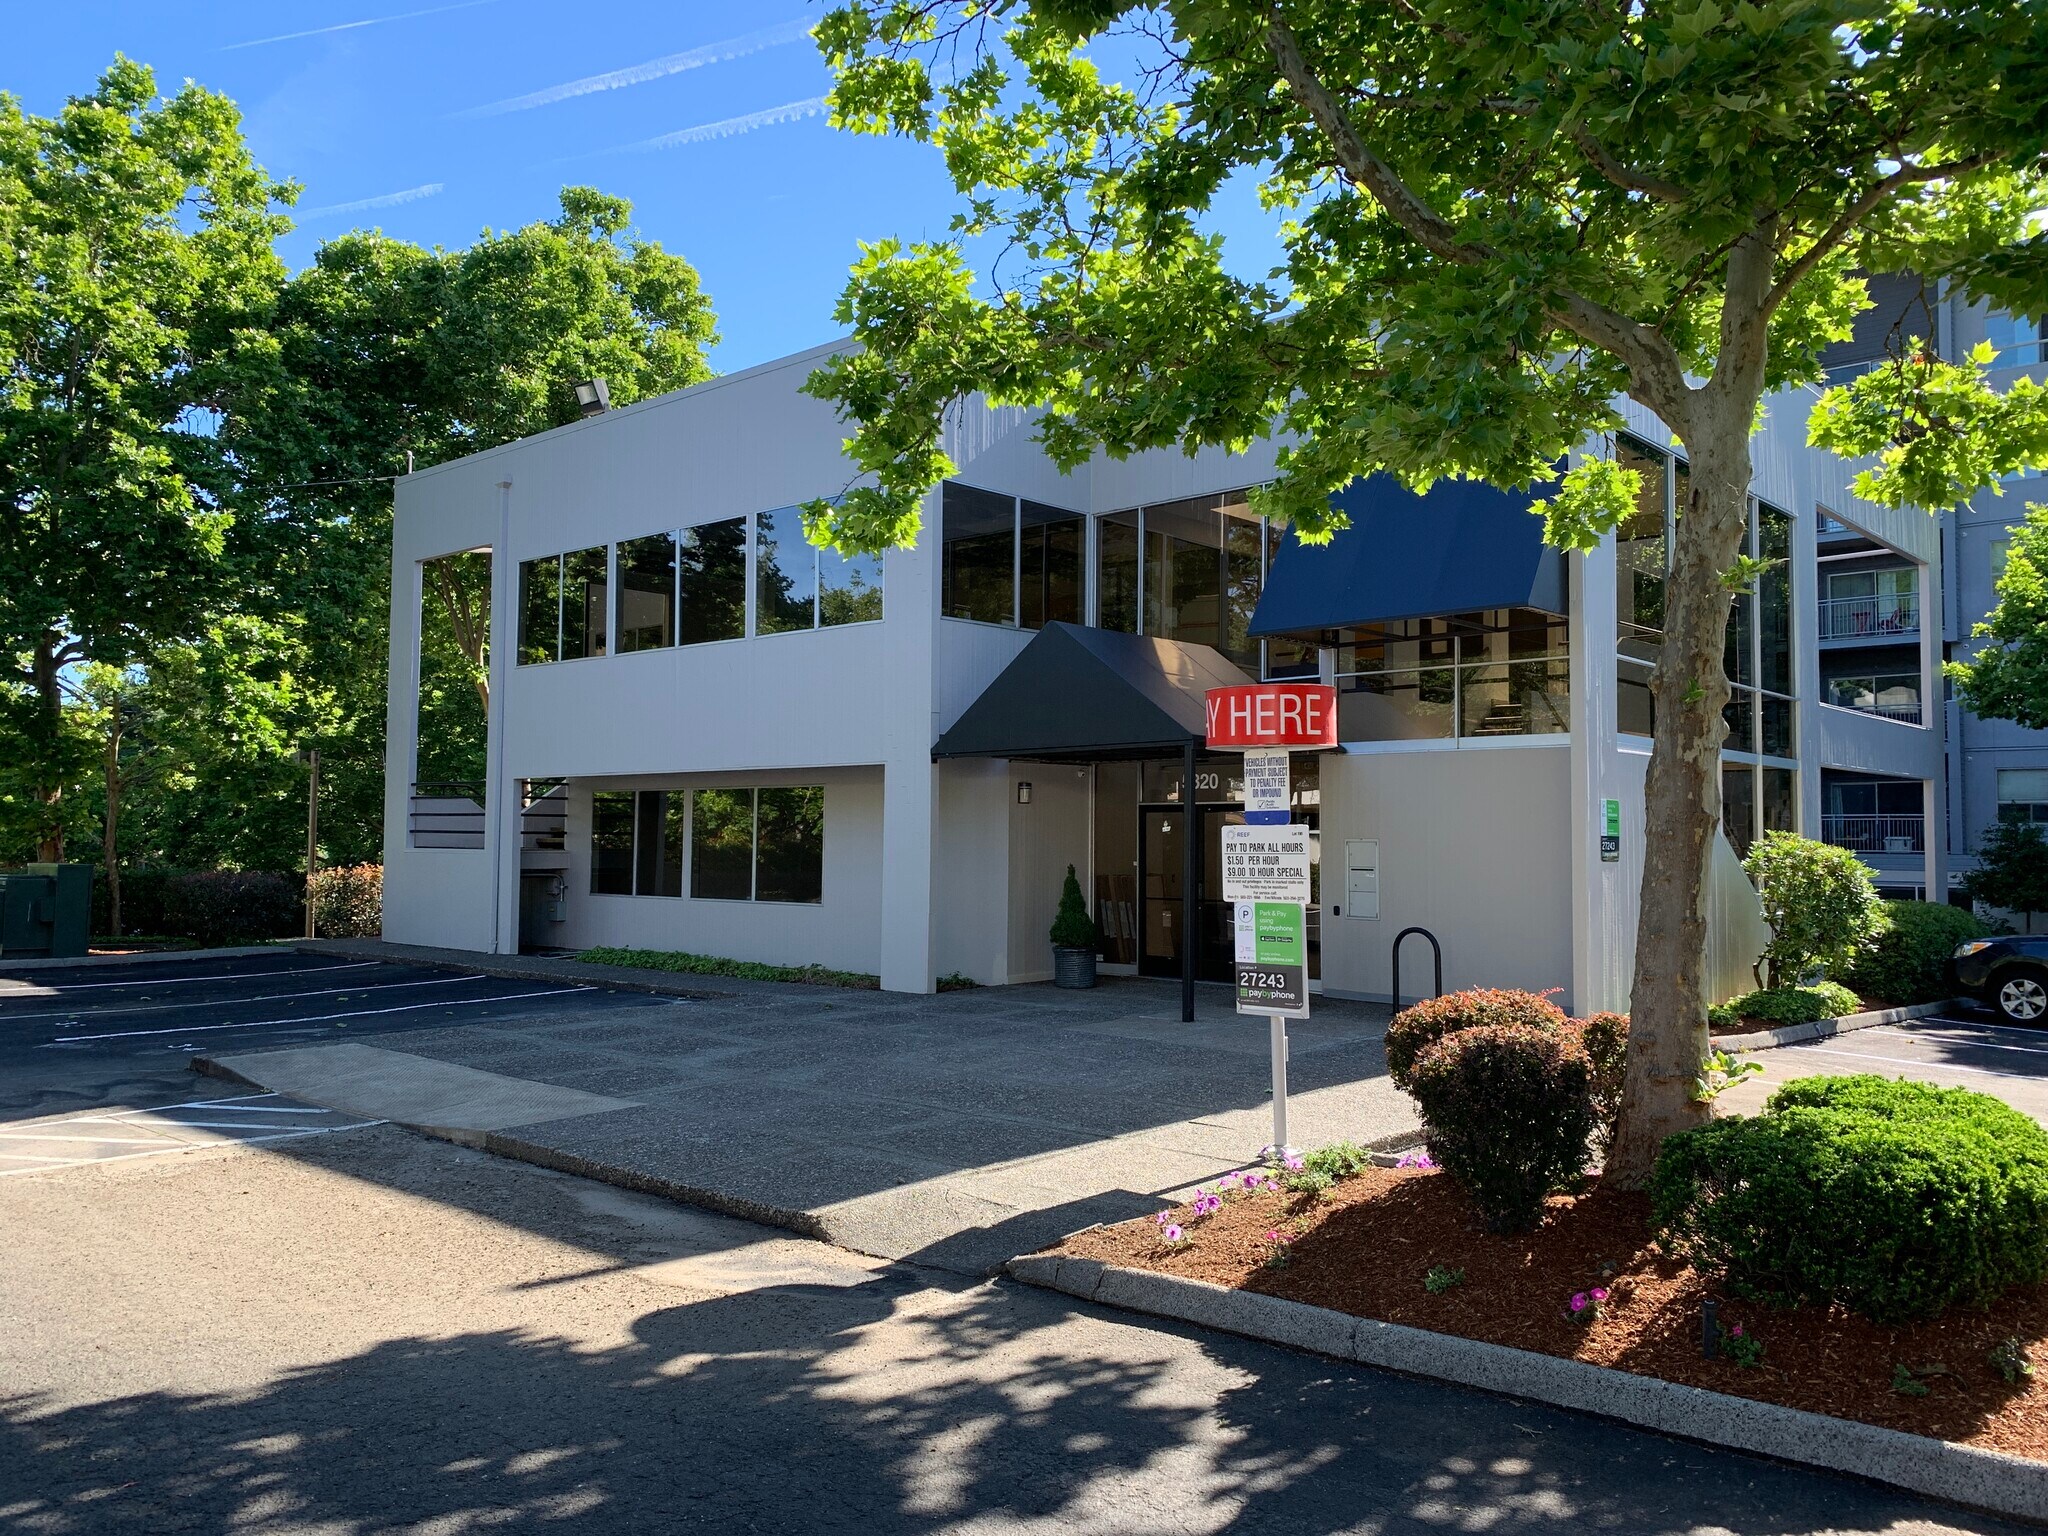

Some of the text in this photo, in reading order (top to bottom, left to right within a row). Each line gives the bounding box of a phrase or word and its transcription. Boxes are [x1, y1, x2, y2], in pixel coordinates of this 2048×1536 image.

[1230, 694, 1322, 737] HERE
[1245, 756, 1287, 767] VEHICLES WITHOUT
[1245, 767, 1288, 777] PAYMENT SUBJECT
[1250, 777, 1286, 787] TO PENALTY FEE
[1253, 788, 1281, 798] OR IMPOUND
[1226, 842, 1303, 852] PAY TO PARK ALL HOURS
[1602, 841, 1615, 850] 27243
[1227, 855, 1279, 865] $1.50 PER HOUR
[1227, 867, 1304, 877] $9.00 10 HOUR SPECIAL
[1243, 910, 1249, 918] P
[1277, 910, 1287, 918] Pay
[1240, 971, 1285, 989] 27243
[1248, 989, 1296, 1000] paybyphone
